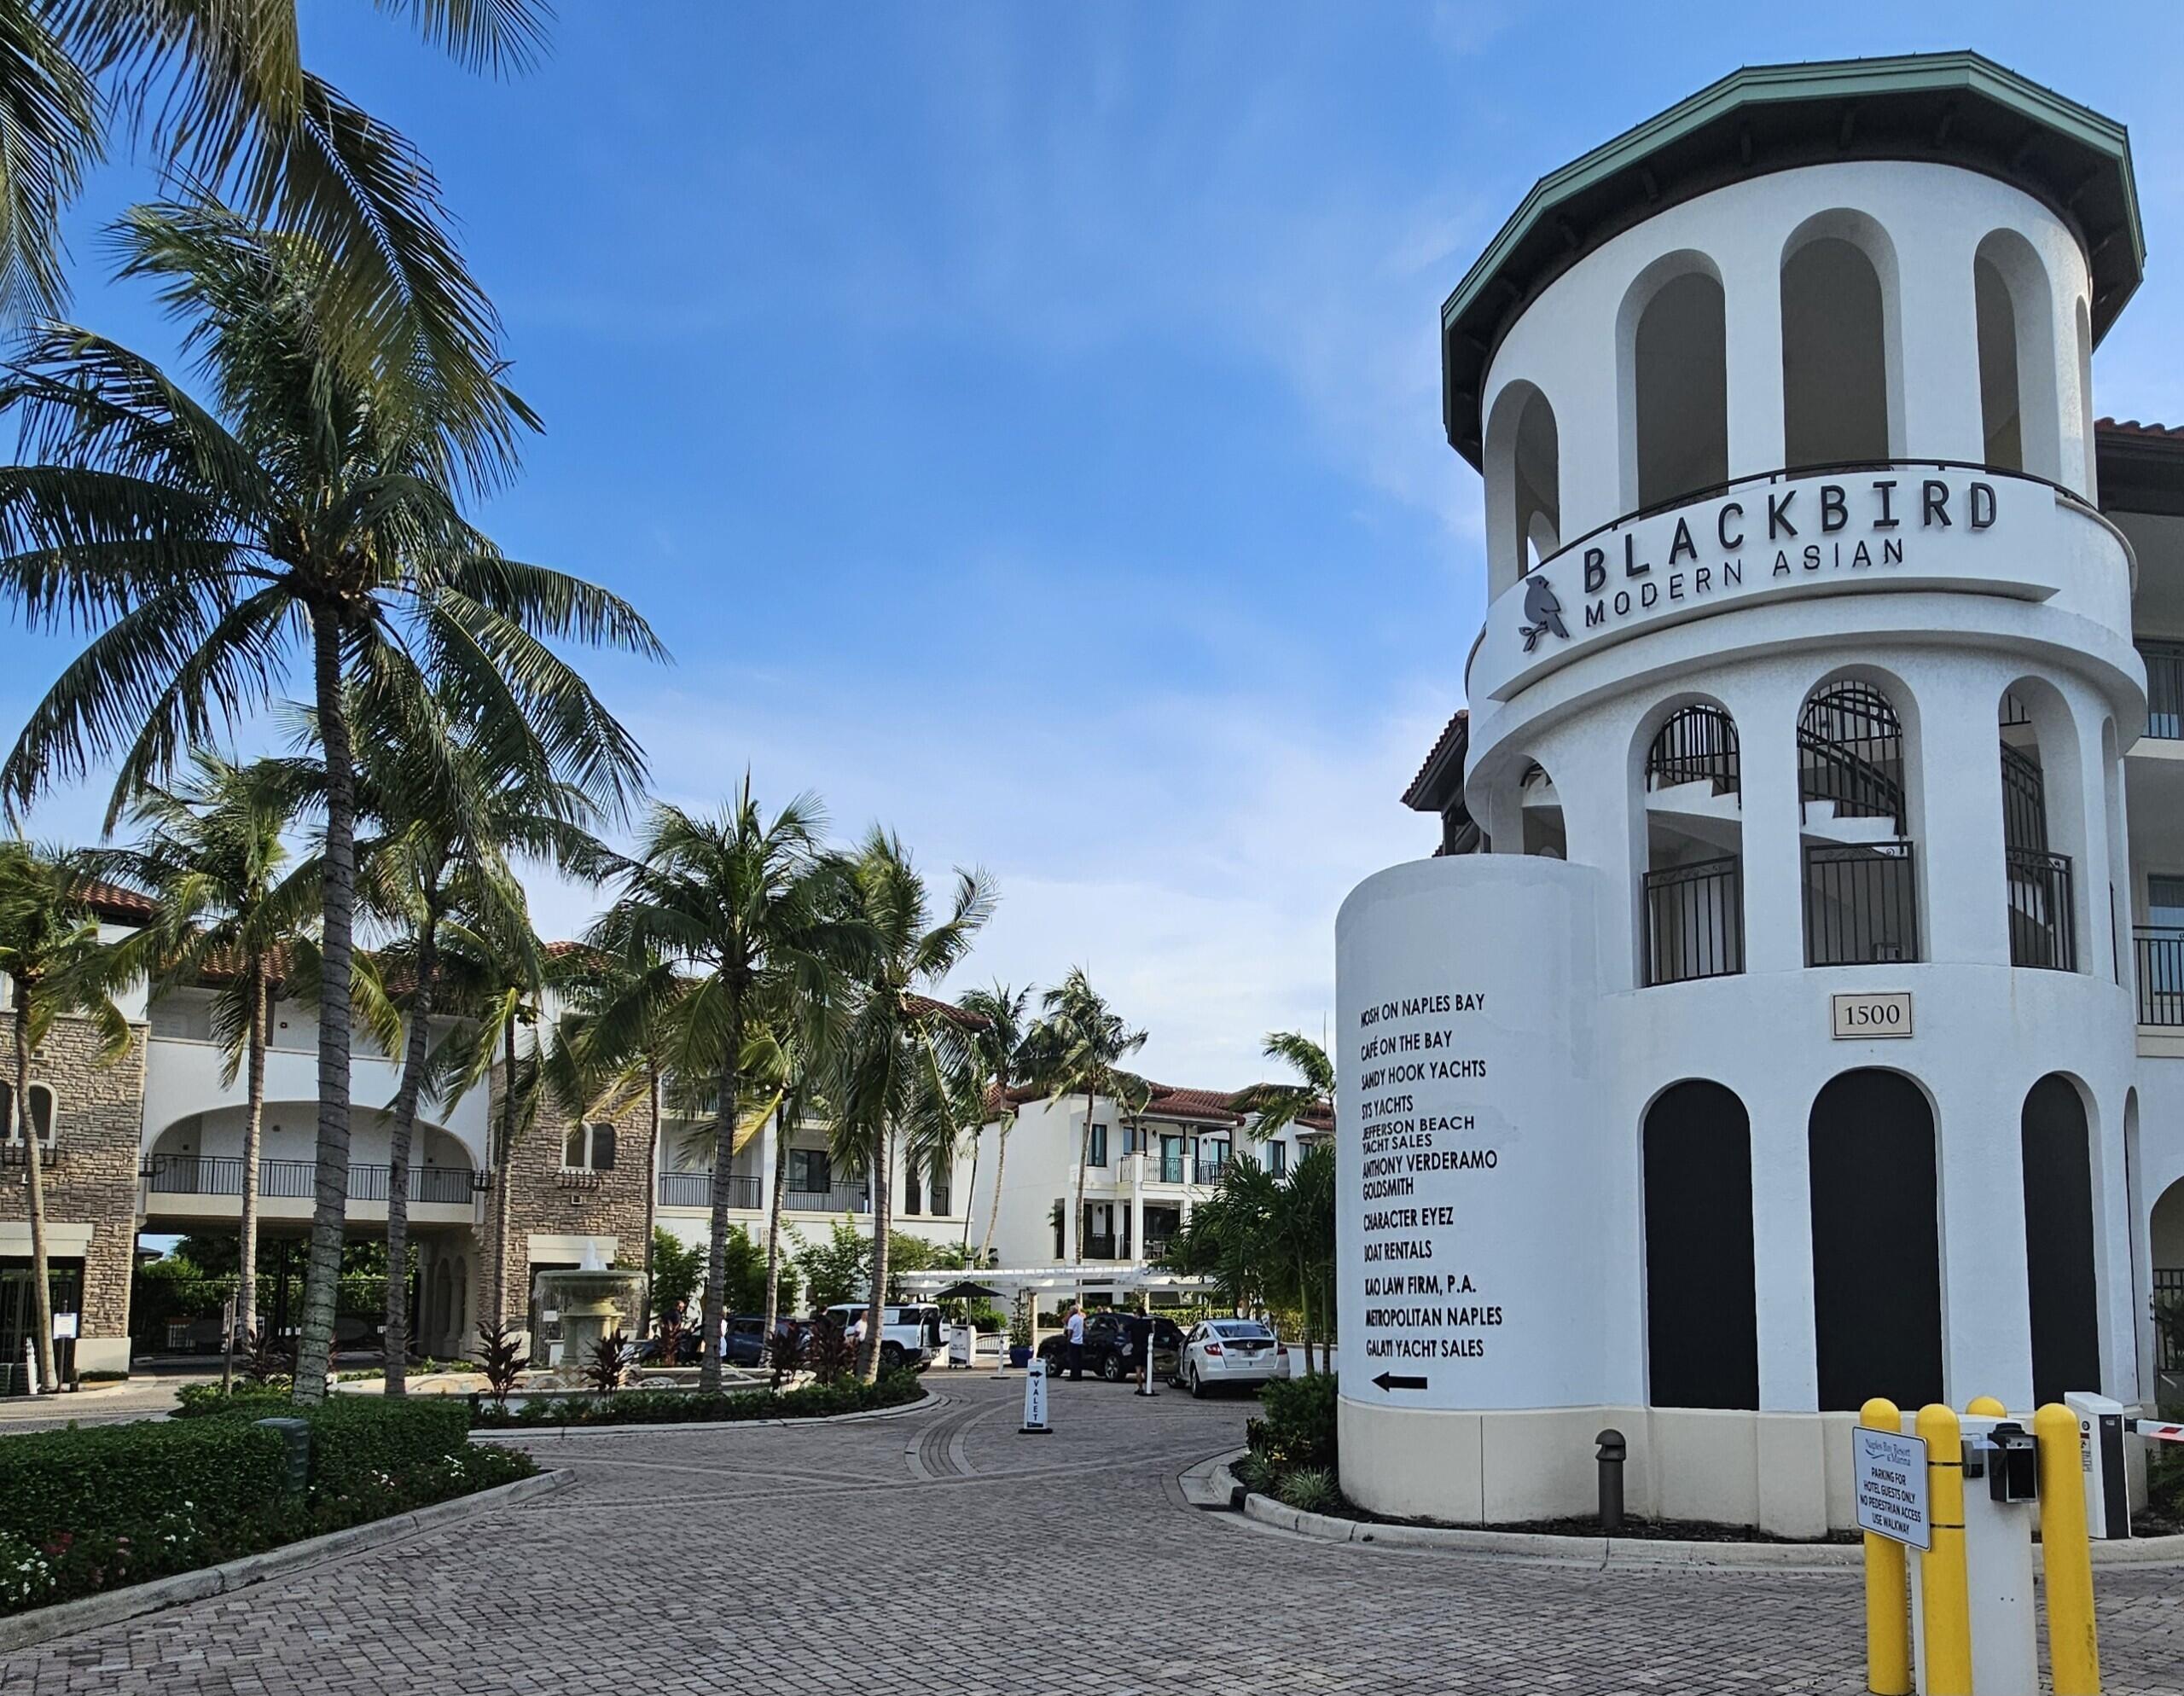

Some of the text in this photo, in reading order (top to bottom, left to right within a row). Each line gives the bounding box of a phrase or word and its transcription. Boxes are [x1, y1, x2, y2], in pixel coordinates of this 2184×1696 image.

[1583, 479, 1997, 594] BLACKBIRD
[1584, 538, 1904, 627] MODERN ASIAN
[1382, 1002, 1398, 1020] ON
[1402, 995, 1450, 1016] NAPLES
[1455, 994, 1485, 1010] BAY
[1844, 1004, 1900, 1025] 1500
[1361, 1031, 1452, 1061] CAFÉ ON THE BAY
[1362, 1060, 1486, 1090] SANDY HOOK YACHTS
[1374, 1095, 1414, 1116] YACHTS
[1362, 1116, 1474, 1140] JEFFERSON BEACH
[1362, 1133, 1432, 1155] YACHT SALES
[1362, 1150, 1497, 1179] ANTHONY VERDERAMO
[1362, 1177, 1414, 1200] GOLDSMITH
[1363, 1207, 1454, 1232] CHARACTER EYEZ
[1365, 1240, 1432, 1262] BOAT RENTALS
[1383, 1276, 1404, 1295] LAW
[1408, 1275, 1443, 1296] FIRM,
[1448, 1275, 1477, 1293] P.A.
[1366, 1307, 1503, 1327] METROPOLITAN NAPLES
[1366, 1339, 1484, 1358] GALATI YACHT SALES
[1871, 1467, 1907, 1486] PARKING FOR
[1863, 1479, 1916, 1505] HOTEL GUESTS ONLY
[1860, 1494, 1921, 1523] NO PEDESTRIAN ACCESS
[1872, 1513, 1910, 1536] USE WALKWAY
